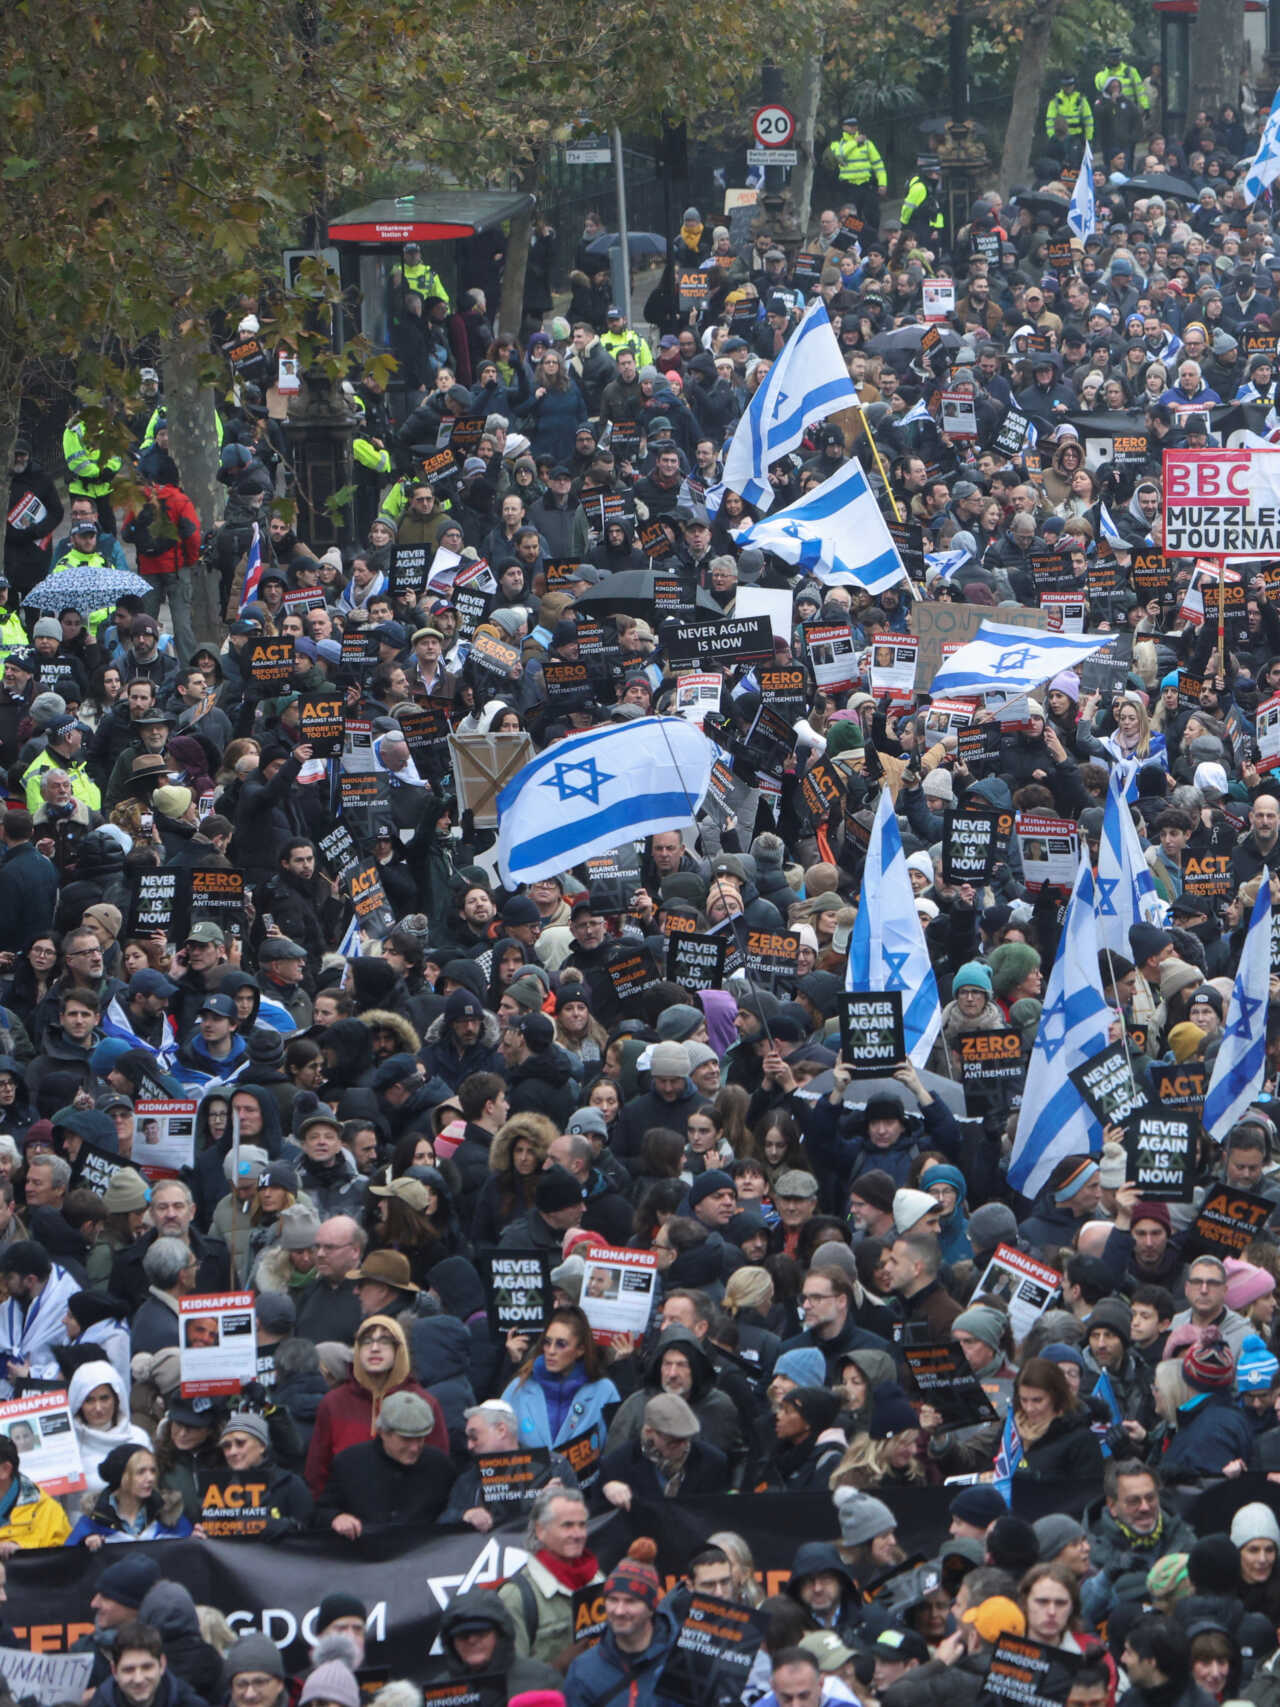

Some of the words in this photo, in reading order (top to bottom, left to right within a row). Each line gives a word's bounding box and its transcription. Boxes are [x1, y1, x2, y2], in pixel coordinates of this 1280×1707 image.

[760, 117, 788, 134] 20
[681, 274, 707, 284] ACT
[1248, 338, 1276, 349] ACT
[1114, 437, 1146, 448] ZERO
[1167, 464, 1250, 496] BBC
[397, 550, 425, 558] NEVER
[396, 558, 425, 568] AGAIN
[1134, 555, 1167, 569] ACT
[406, 568, 414, 576] IS
[396, 576, 422, 585] NOW!
[678, 626, 717, 640] NEVER
[720, 620, 758, 635] AGAIN
[698, 642, 709, 652] IS
[712, 637, 742, 650] NOW
[252, 644, 292, 661] ACT
[41, 664, 71, 674] NEVER
[762, 672, 803, 684] ZERO
[302, 702, 342, 719] ACT
[811, 766, 840, 801] ACT
[952, 819, 992, 832] NEVER
[319, 826, 347, 850] NEVER
[950, 832, 991, 844] AGAIN
[326, 835, 354, 861] AGAIN
[964, 846, 975, 858] IS
[952, 858, 986, 870] NOW!
[1185, 857, 1230, 874] ACT
[142, 875, 176, 886] NEVER
[193, 872, 242, 886] ZERO
[351, 867, 376, 896] ACT
[139, 888, 174, 898] AGAIN
[151, 900, 161, 910] IS
[139, 912, 170, 923] NOW!
[678, 940, 718, 954] NEVER
[749, 932, 798, 952] ZERO
[677, 952, 718, 966] AGAIN
[690, 966, 700, 977] IS
[676, 975, 712, 989] NOW!
[848, 1002, 894, 1015] NEVER
[849, 1016, 894, 1030] AGAIN
[866, 1032, 880, 1044] IS
[962, 1035, 1020, 1052] ZERO
[854, 1045, 894, 1059] NOW!
[964, 1067, 1022, 1079] ANTISEMITES
[1082, 1054, 1125, 1086] NEVER
[1091, 1066, 1130, 1100] AGAIN
[1160, 1074, 1204, 1098] ACT
[1112, 1088, 1128, 1103] IS
[138, 1103, 194, 1112] KIDNAPPED
[1109, 1092, 1148, 1122] NOW!
[1140, 1120, 1188, 1136] NEVER
[1137, 1136, 1188, 1153] AGAIN
[1154, 1154, 1168, 1168] IS
[1138, 1169, 1184, 1184] NOW!
[1205, 1194, 1266, 1225] ACT
[590, 1248, 655, 1264] KIDNAPPED
[492, 1259, 540, 1273] NEVER
[998, 1248, 1057, 1284] KIDNAPPED
[493, 1276, 542, 1288] AGAIN
[182, 1296, 252, 1310] KIDNAPPED
[512, 1292, 526, 1304] IS
[498, 1306, 544, 1320] NOW!
[480, 1468, 494, 1477] TO
[202, 1484, 266, 1508] ACT
[483, 1484, 509, 1494] WITH
[202, 1508, 240, 1517] AGAINST
[242, 1507, 266, 1516] HATE
[690, 1608, 704, 1620] TO
[682, 1627, 712, 1643] WITH
[677, 1636, 720, 1656] BRITISH
[995, 1649, 1049, 1672] KINGDOM
